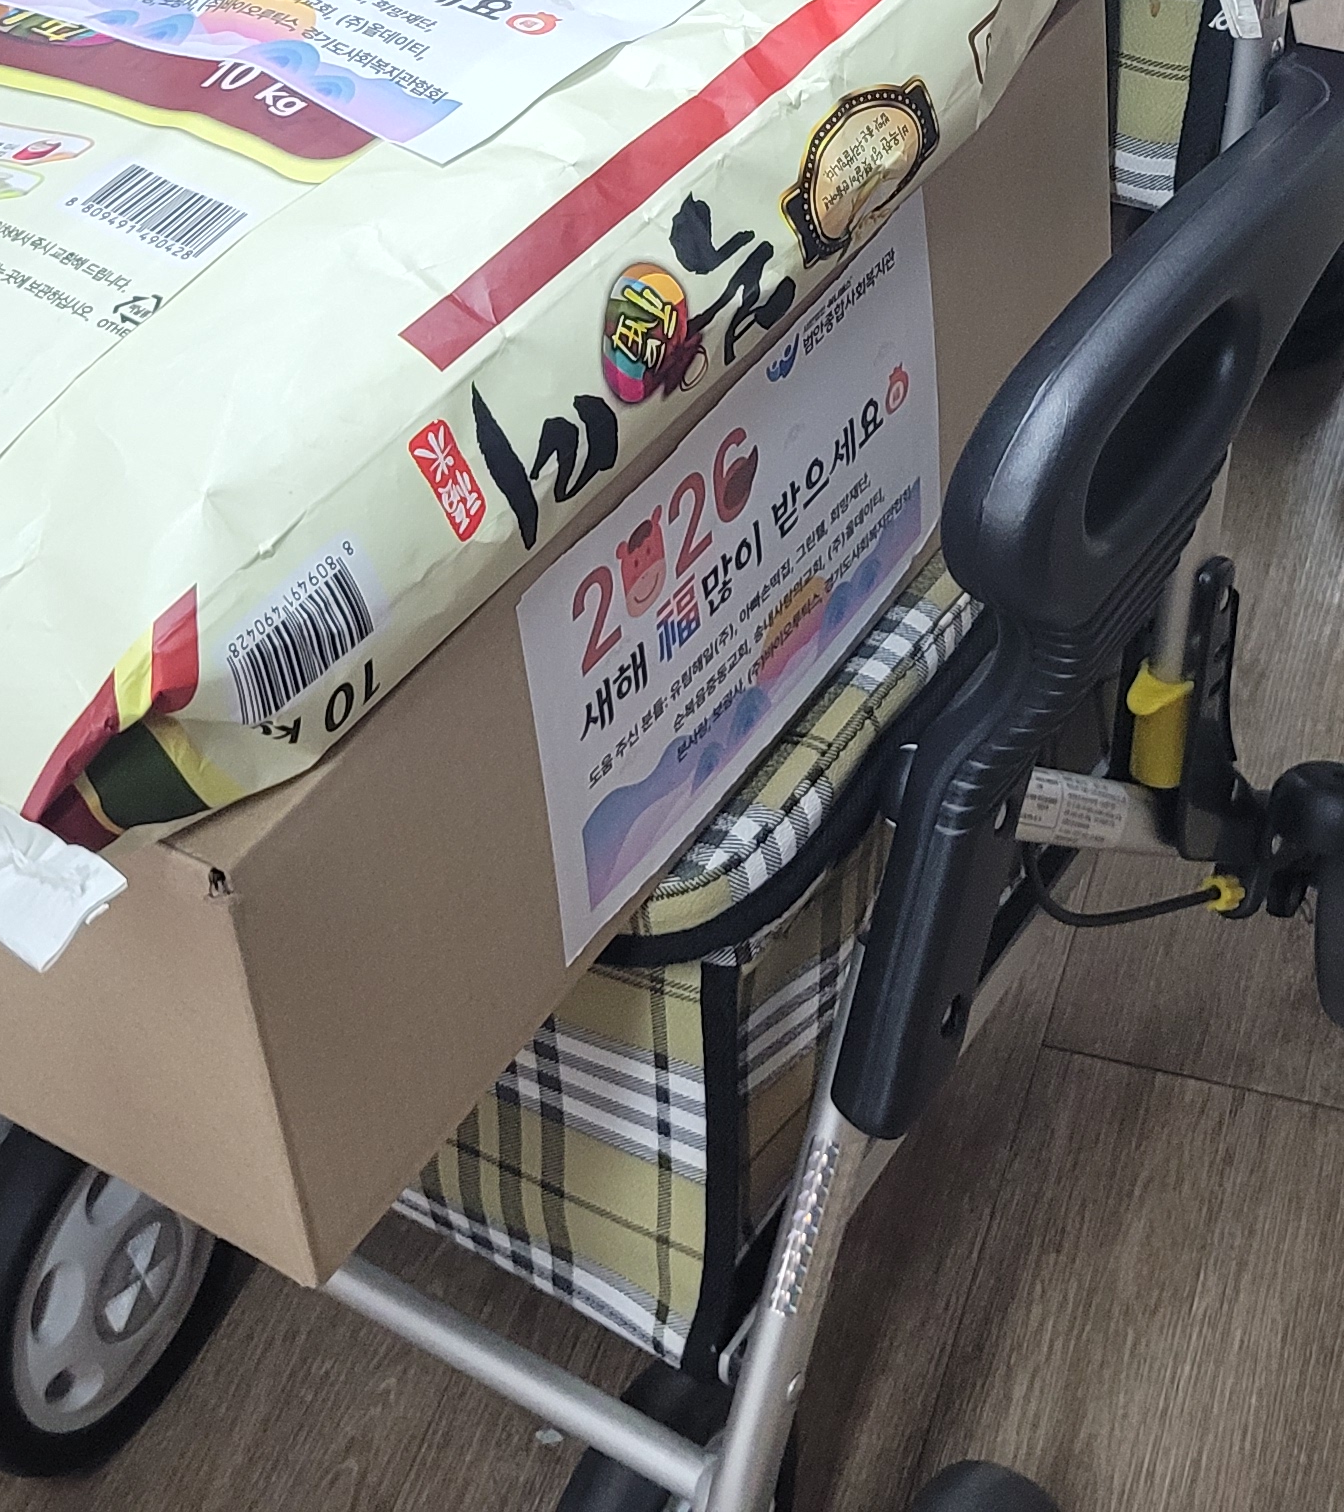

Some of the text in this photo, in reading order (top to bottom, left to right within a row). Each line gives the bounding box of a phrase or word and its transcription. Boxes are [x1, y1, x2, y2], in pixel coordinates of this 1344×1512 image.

[371, 0, 439, 33] 희망재단,
[200, 60, 258, 92] 10
[301, 26, 449, 105] 경기도사회복지관협회
[879, 124, 909, 154] 비옥한
[65, 197, 194, 261] 8 809491 490428
[0, 269, 32, 289] 곳에
[24, 279, 94, 322] 보관하십시오.
[81, 263, 132, 293] 드립니다.
[802, 246, 896, 356] 범안종합사회복지관
[96, 318, 132, 338] OTHE
[580, 641, 649, 742] 새해
[701, 519, 762, 617] 많이
[771, 397, 884, 538] 받으세요
[823, 484, 913, 593] 경기도사회복지관협회
[227, 540, 356, 660] 8 809491 490428
[589, 752, 613, 789] 도움
[615, 723, 640, 758] 주신
[641, 696, 669, 733] 분들:
[830, 471, 872, 525] 희망재단,
[324, 657, 381, 733] 10
